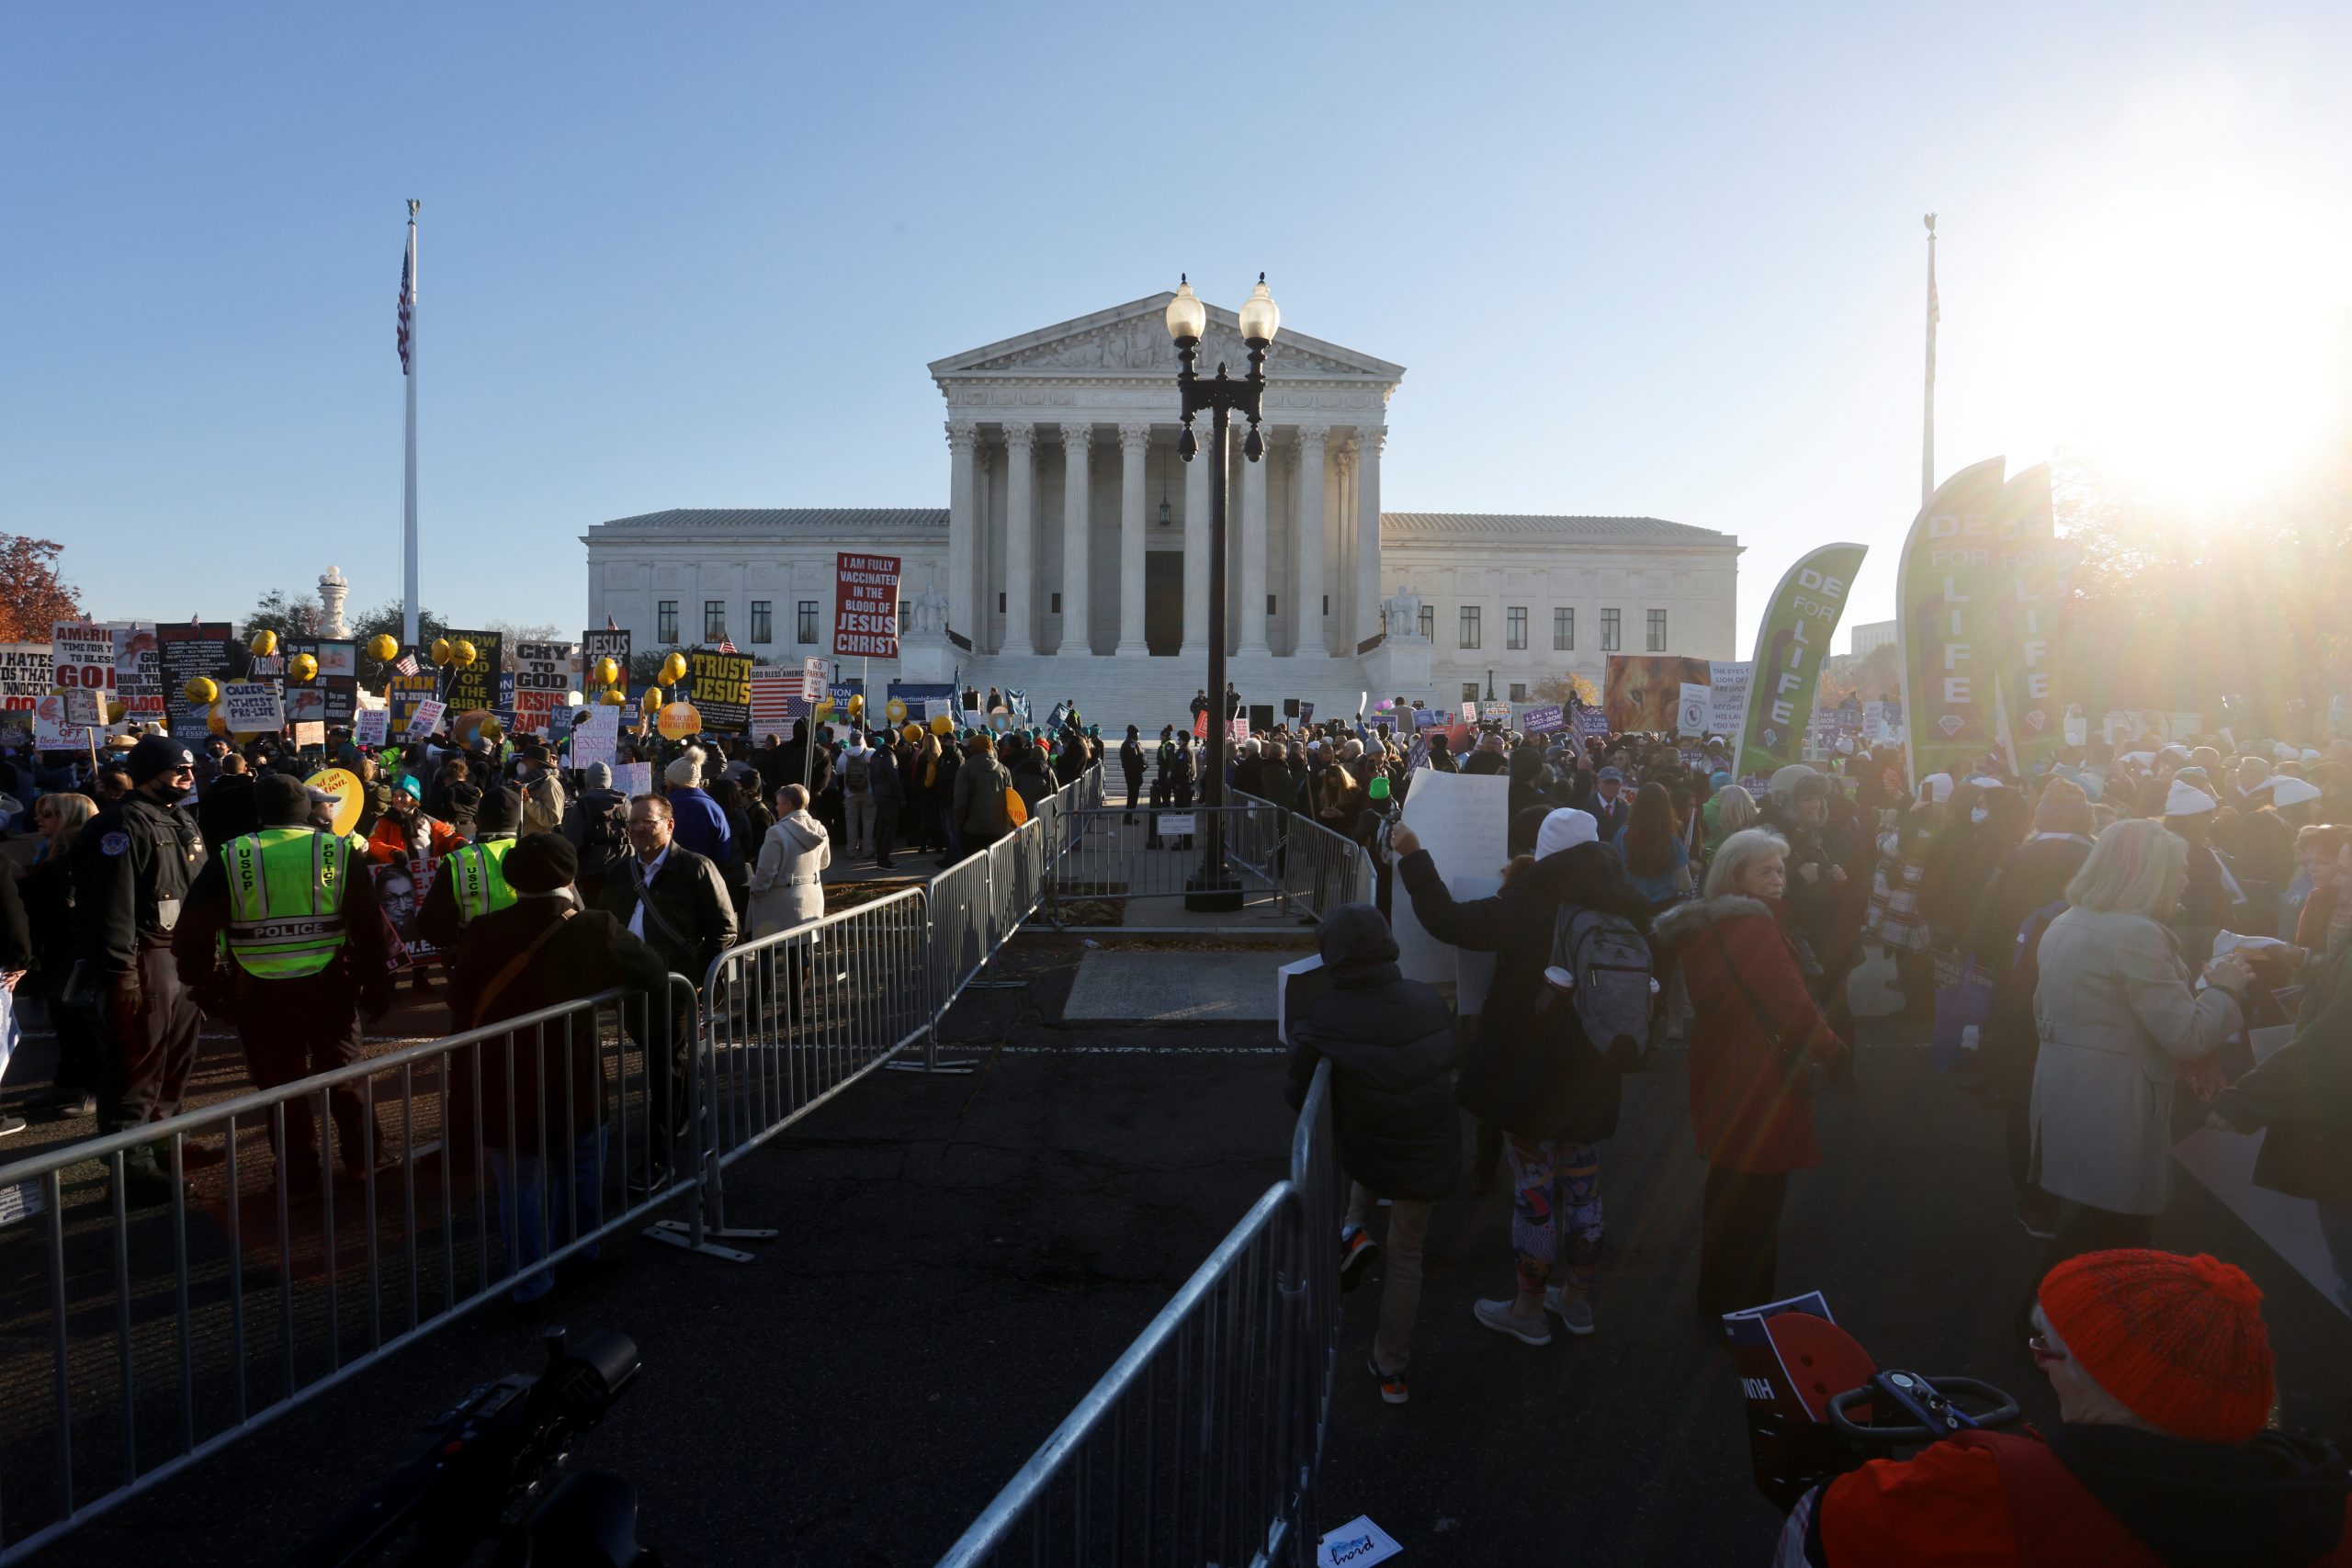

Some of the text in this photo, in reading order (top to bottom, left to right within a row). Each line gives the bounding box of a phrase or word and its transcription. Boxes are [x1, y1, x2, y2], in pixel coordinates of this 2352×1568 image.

[843, 558, 894, 571] I AM FULLY
[1931, 549, 1990, 567] FOR
[840, 571, 898, 586] VACCINATED
[1798, 568, 1844, 599] DE
[853, 586, 883, 599] IN THE
[845, 600, 891, 614] BLOOD OF
[1793, 595, 1836, 623] FOR
[838, 613, 895, 634] JESUS
[56, 627, 113, 642] AMERIC
[1944, 576, 1972, 703] LIFE
[2016, 578, 2050, 699] LIFE
[62, 643, 85, 651] TIME
[87, 644, 104, 652] FOR
[300, 646, 315, 654] you
[585, 635, 628, 655] JESUS
[837, 634, 896, 654] CHRIST
[516, 644, 571, 660] CRY
[529, 661, 556, 672] TO
[591, 654, 623, 668] SAES
[693, 654, 753, 681] TRUST
[813, 661, 822, 670] NO
[117, 674, 142, 683] HANDS
[461, 673, 483, 684] OF
[807, 670, 827, 680] PARKING
[1770, 618, 1809, 726] LIFE
[316, 677, 327, 686] OR
[516, 672, 568, 689] GOD
[225, 685, 264, 695] QUEER
[458, 686, 487, 697] THE
[691, 678, 751, 705] JESUS
[227, 697, 273, 707] ATHEIST
[424, 702, 441, 710] STOP
[516, 691, 565, 712] JESUS
[232, 708, 275, 718] PRO-LIFE
[1531, 719, 1562, 730] ENERATION
[59, 728, 84, 737] OFF
[328, 772, 341, 782] an
[239, 849, 253, 891] USCP
[323, 843, 334, 886] POLICE
[467, 867, 479, 897] USCP
[254, 923, 324, 938] POLICE
[1329, 1534, 1374, 1566] pray
